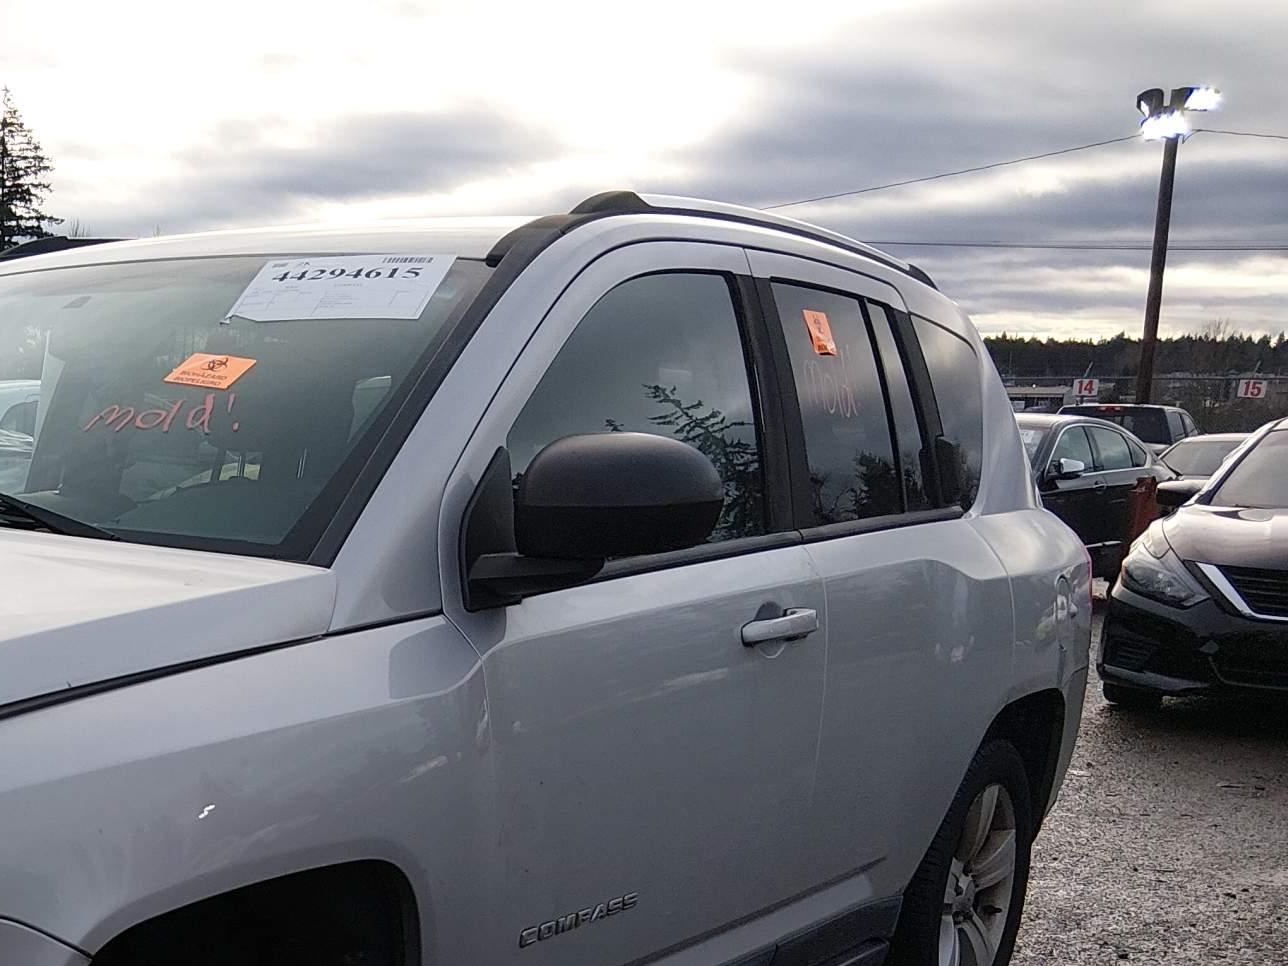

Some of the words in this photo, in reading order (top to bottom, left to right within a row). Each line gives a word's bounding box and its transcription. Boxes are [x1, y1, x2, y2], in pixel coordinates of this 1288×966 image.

[272, 267, 423, 282] 44294615
[1078, 379, 1095, 394] 14
[1243, 381, 1262, 396] 15
[519, 892, 638, 948] COMPASS
